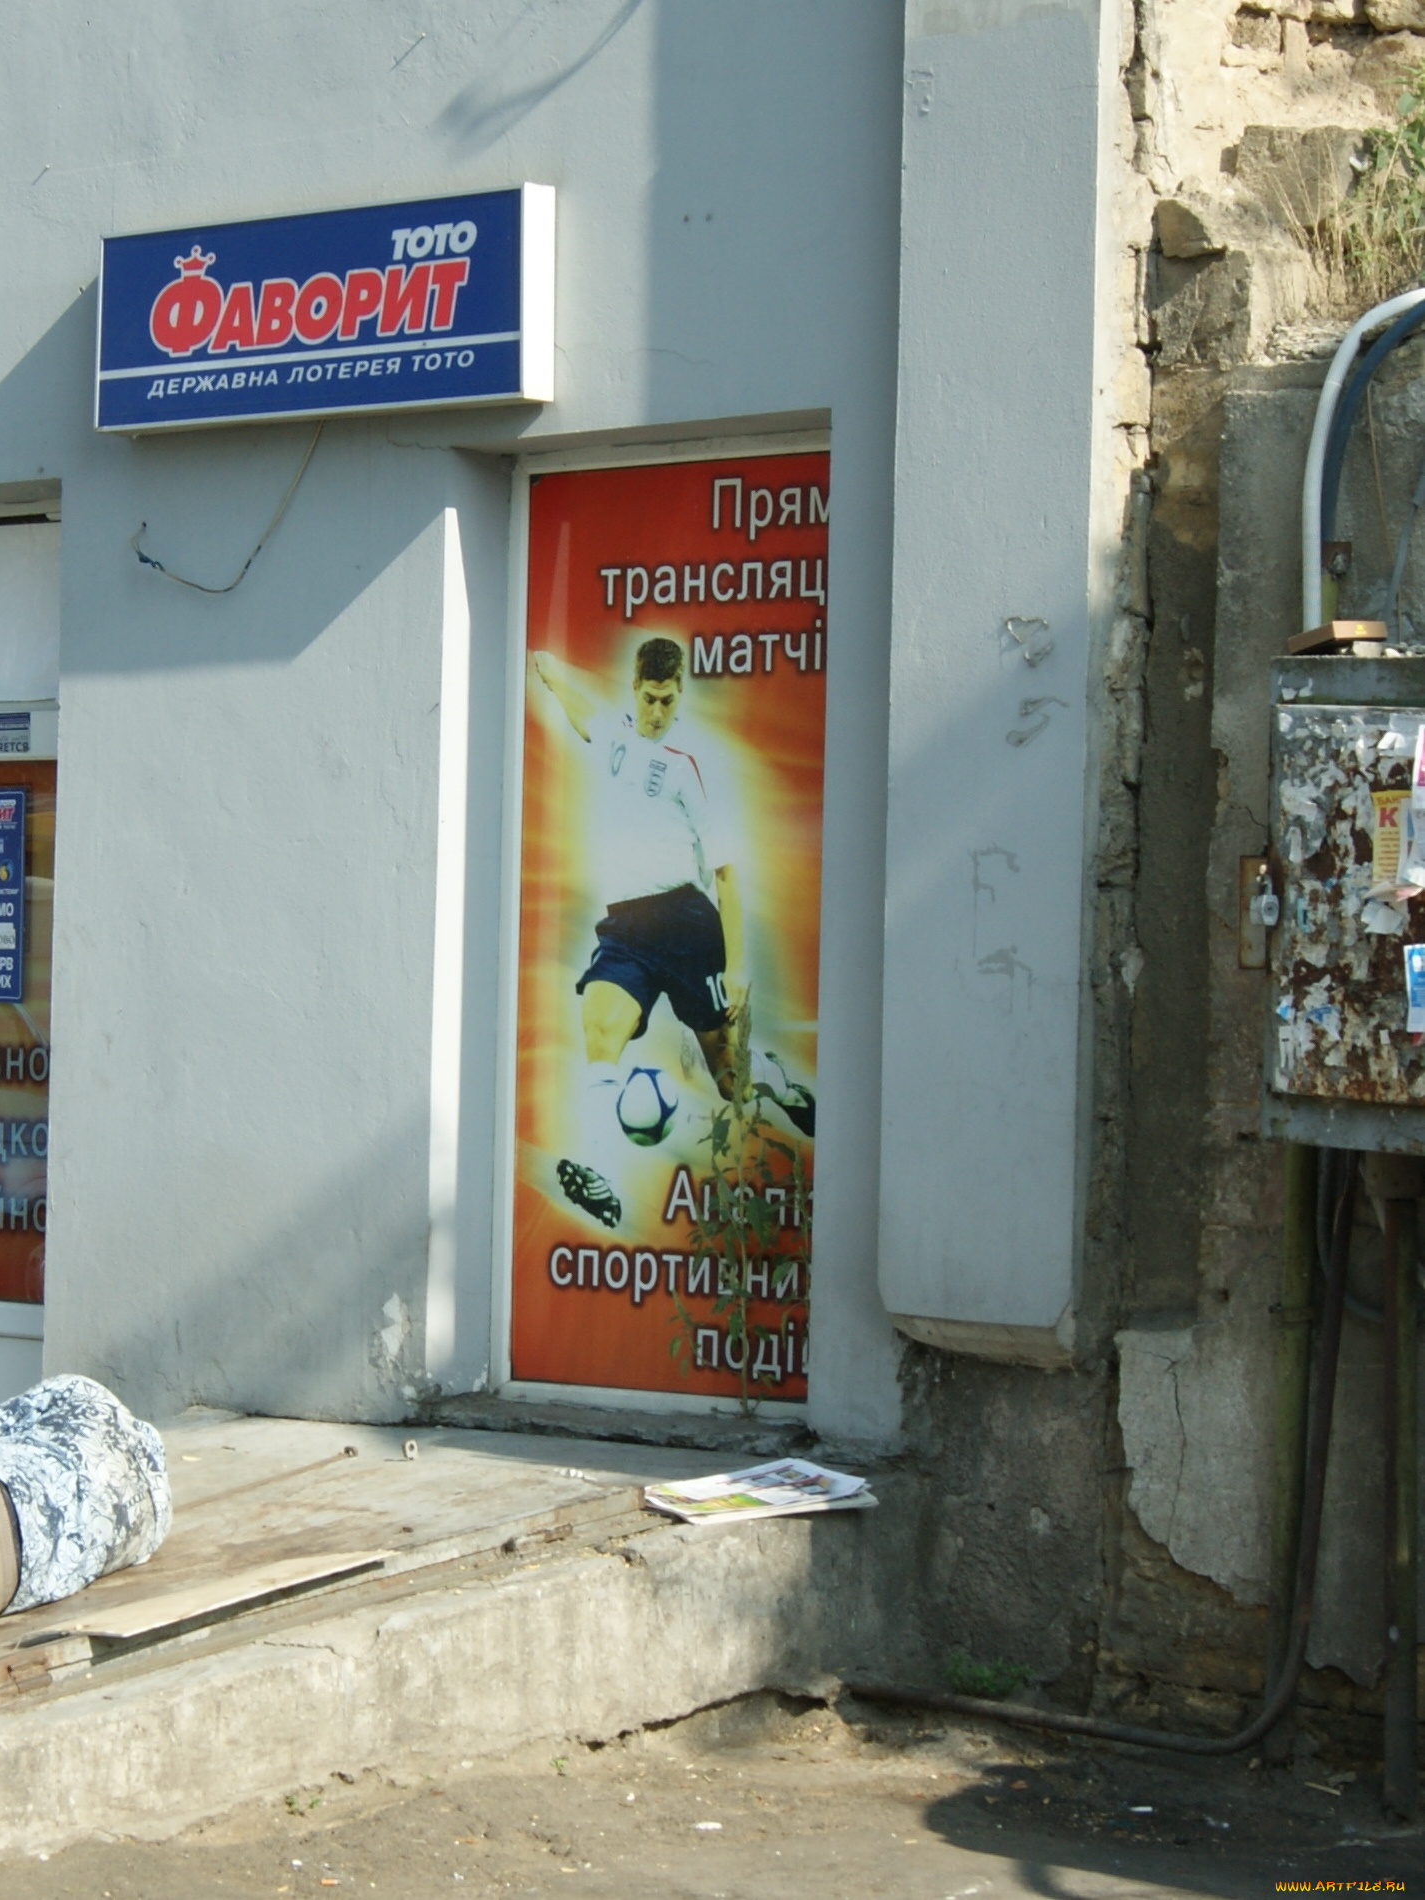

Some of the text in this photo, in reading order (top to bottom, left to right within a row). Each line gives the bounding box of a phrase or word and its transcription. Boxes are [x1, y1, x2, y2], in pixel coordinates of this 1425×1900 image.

[391, 220, 477, 260] ТОТО
[149, 257, 470, 358] ФАВОРИТ
[147, 350, 475, 399] ДЕРЖАВНА ЛОТЕРЕЯ ТОТО
[600, 559, 825, 618] трансляц
[693, 619, 822, 674] матчі
